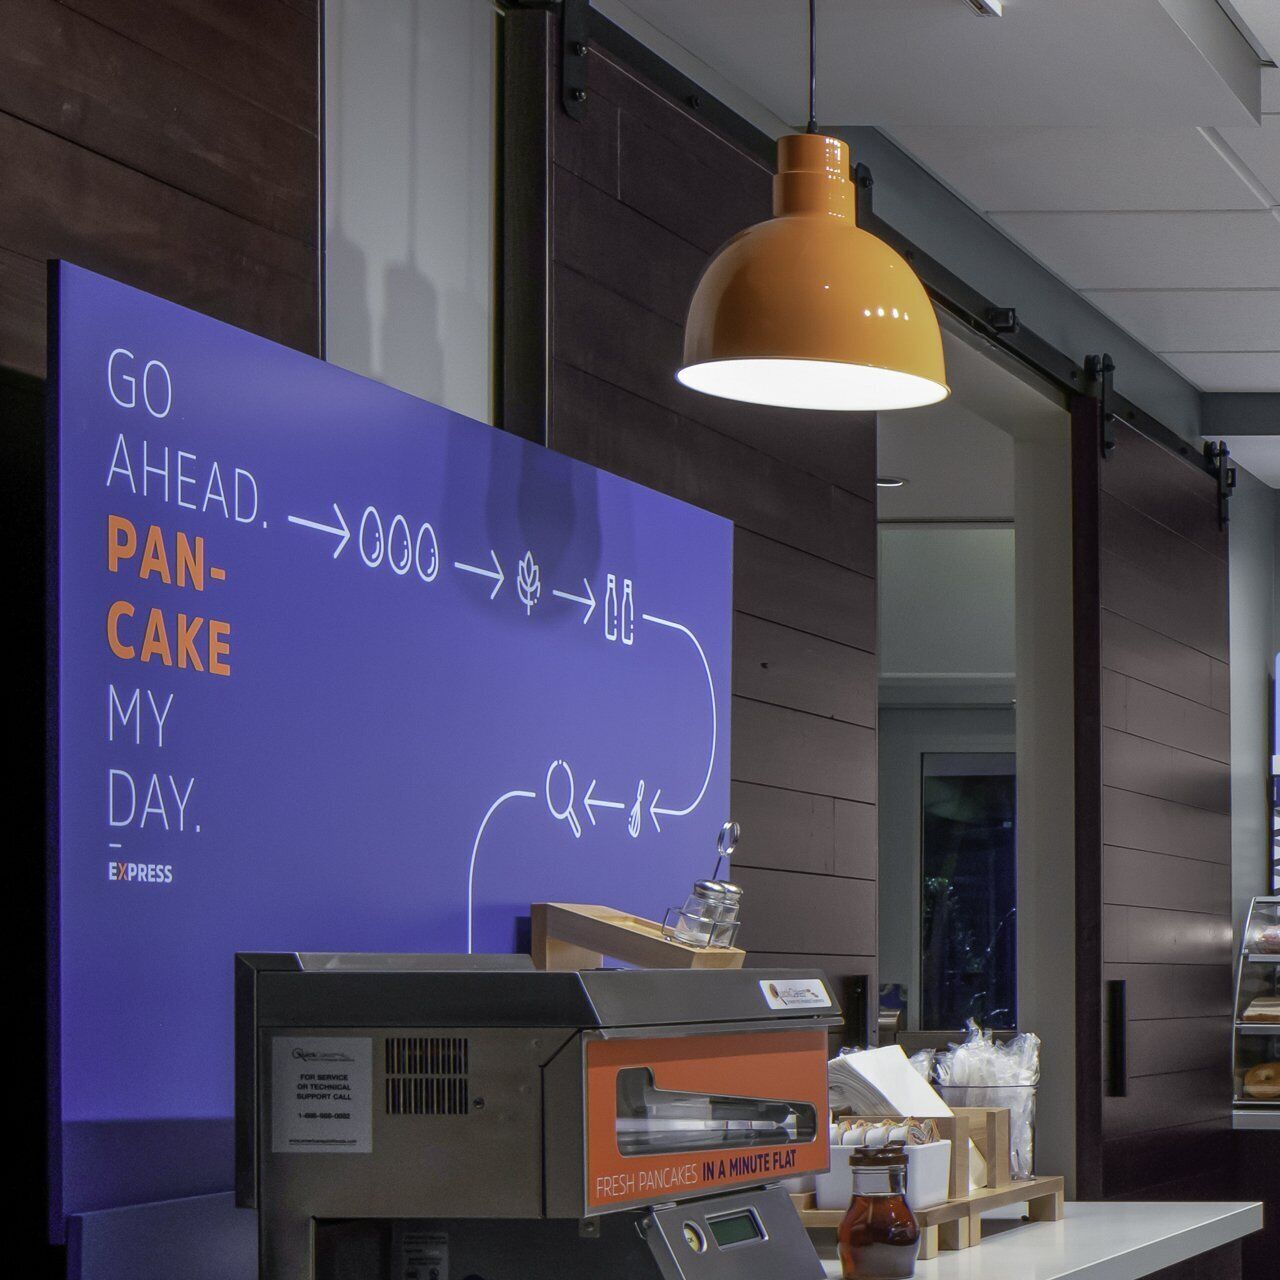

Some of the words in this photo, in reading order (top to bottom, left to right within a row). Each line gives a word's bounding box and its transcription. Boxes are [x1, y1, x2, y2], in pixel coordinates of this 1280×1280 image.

[108, 348, 172, 418] GO
[107, 433, 267, 528] AHEAD.
[108, 514, 226, 591] PAN-
[107, 600, 231, 677] CAKE
[109, 683, 173, 747] MY
[109, 769, 200, 833] DAY.
[108, 861, 173, 883] EXPRESS
[596, 1174, 635, 1198] FRESH
[639, 1163, 698, 1191] PANCAKES
[702, 1160, 715, 1181] IN
[718, 1159, 726, 1178] A
[729, 1153, 770, 1177] MINUTE
[773, 1149, 797, 1170] FLAT
